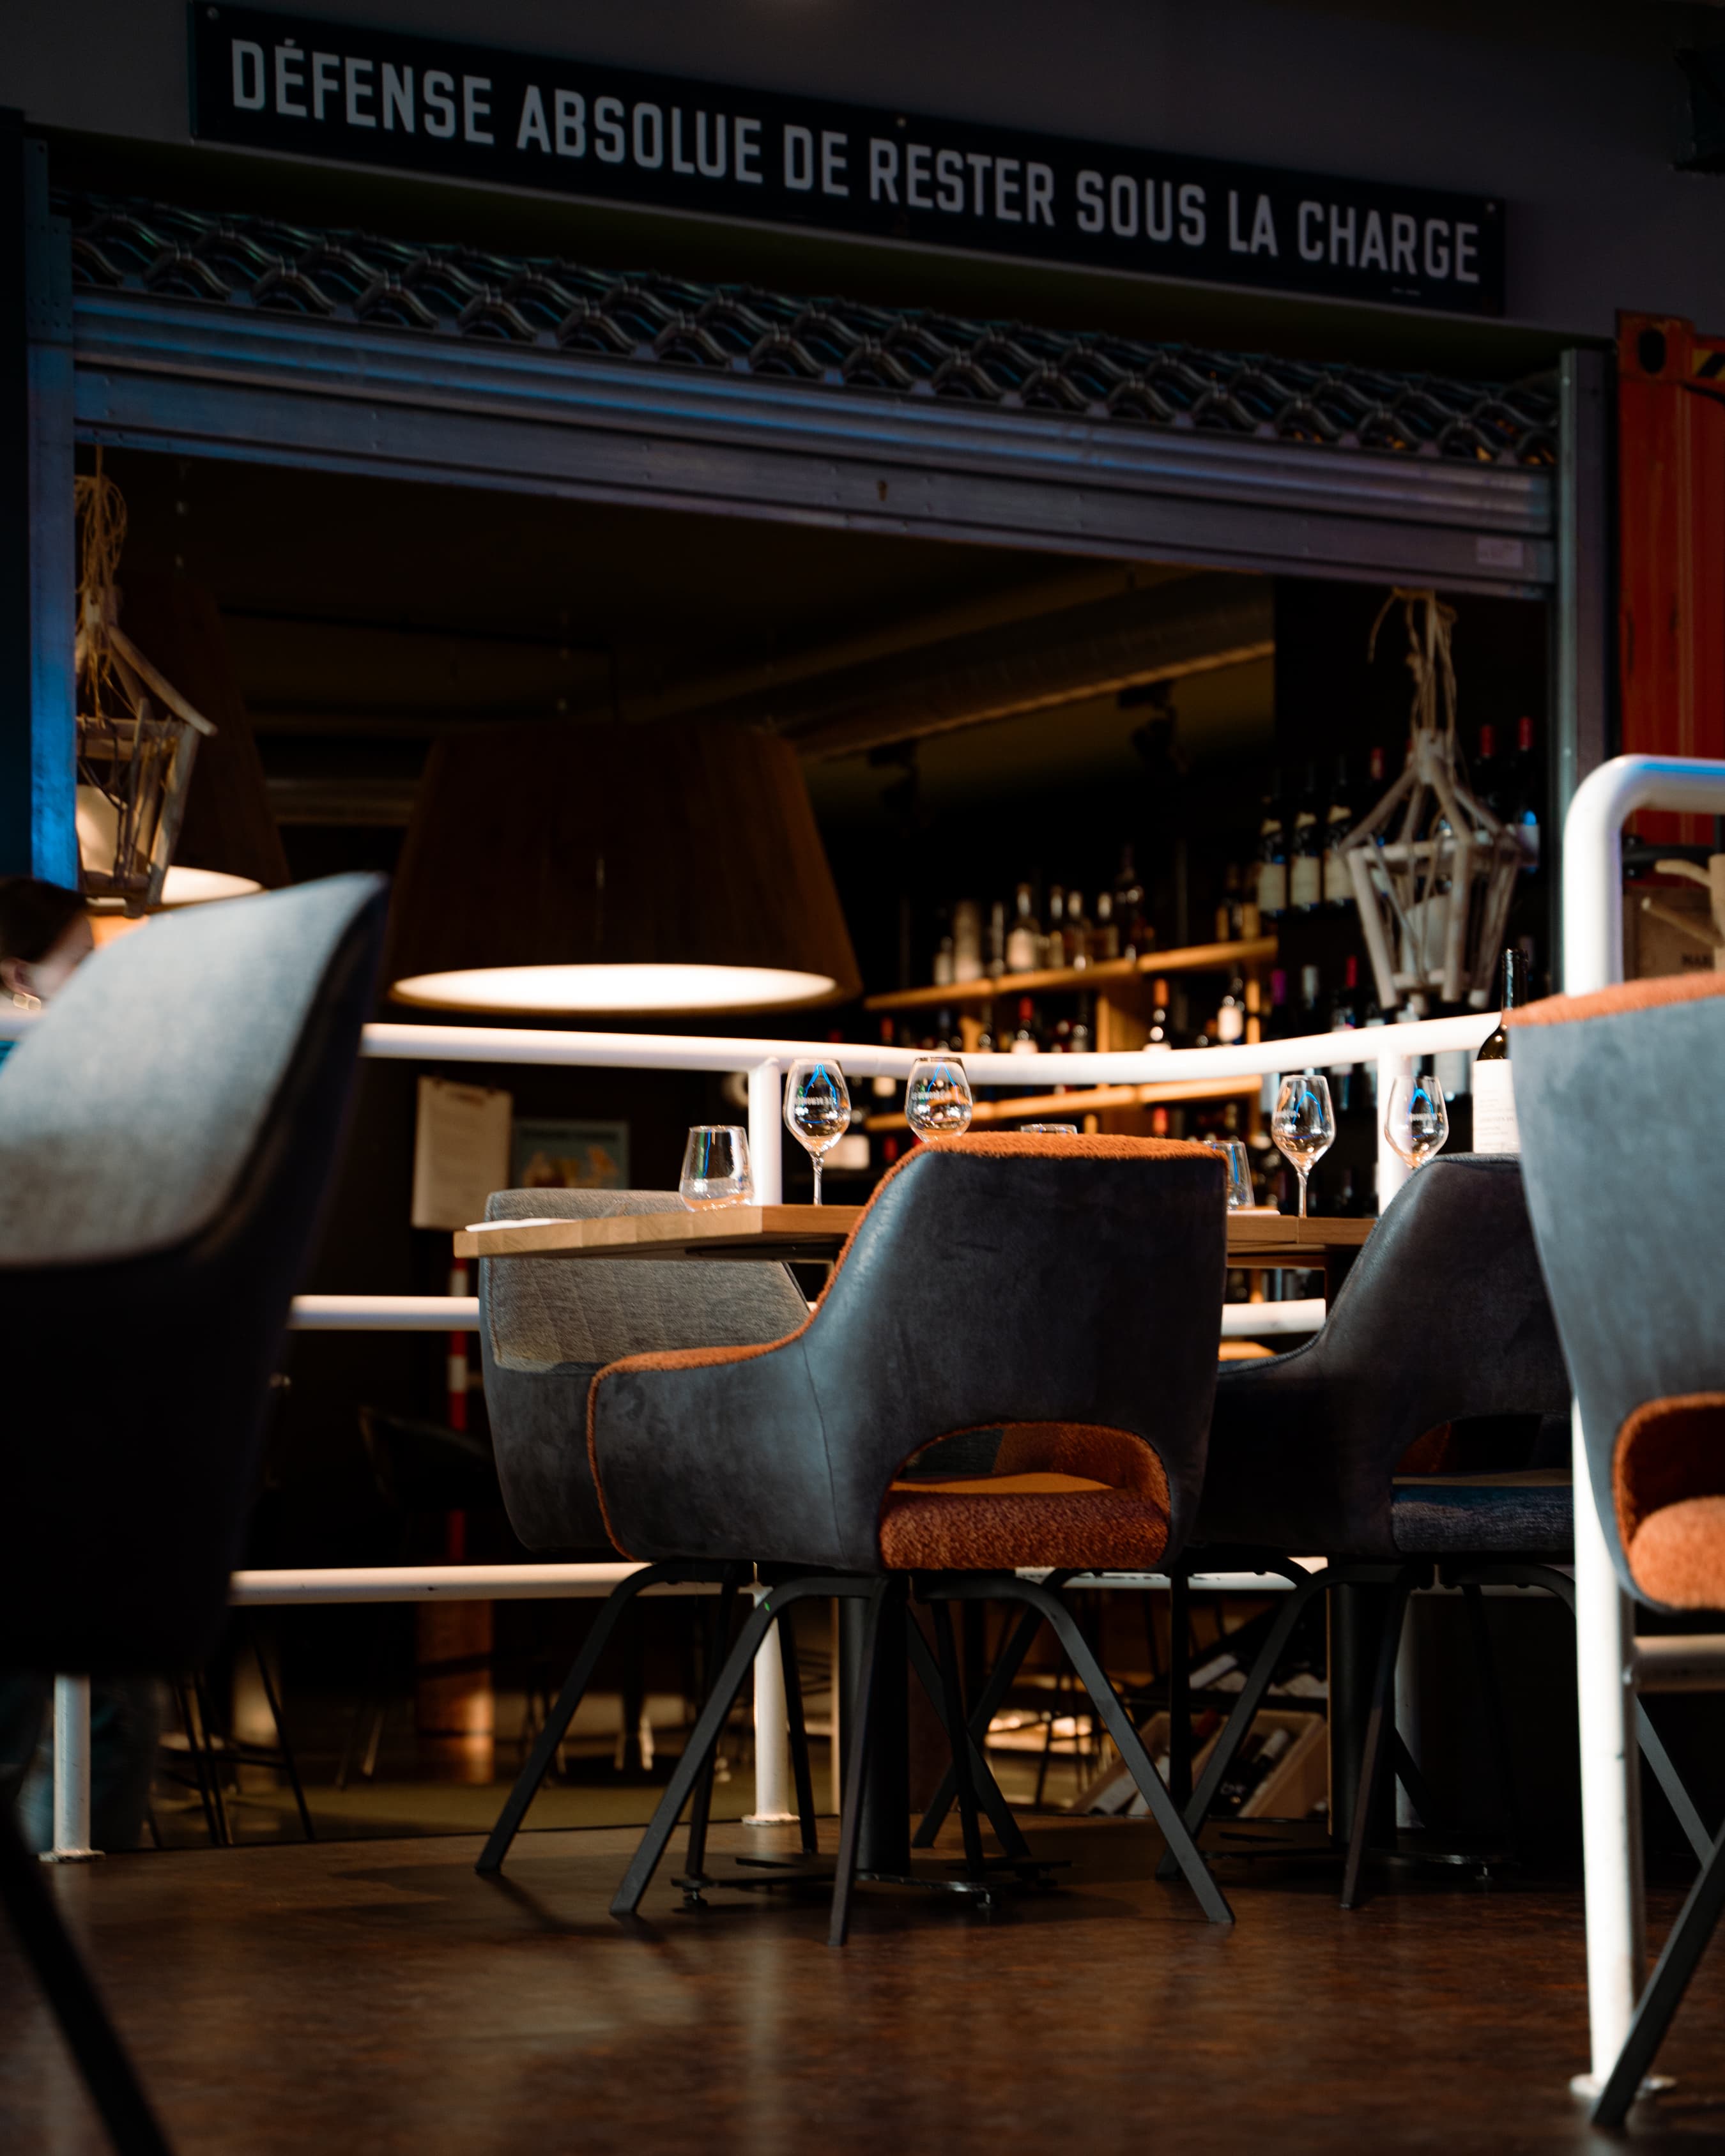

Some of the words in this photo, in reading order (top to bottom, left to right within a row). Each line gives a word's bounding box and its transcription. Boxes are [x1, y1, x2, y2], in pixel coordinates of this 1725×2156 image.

[232, 38, 494, 144] DÉFENSE
[517, 85, 763, 183] ABSOLUE
[785, 125, 848, 196] DE
[870, 139, 1054, 226] RESTER
[1077, 171, 1205, 245] SOUS
[1229, 192, 1277, 256] LA
[1298, 202, 1479, 282] CHARGE
